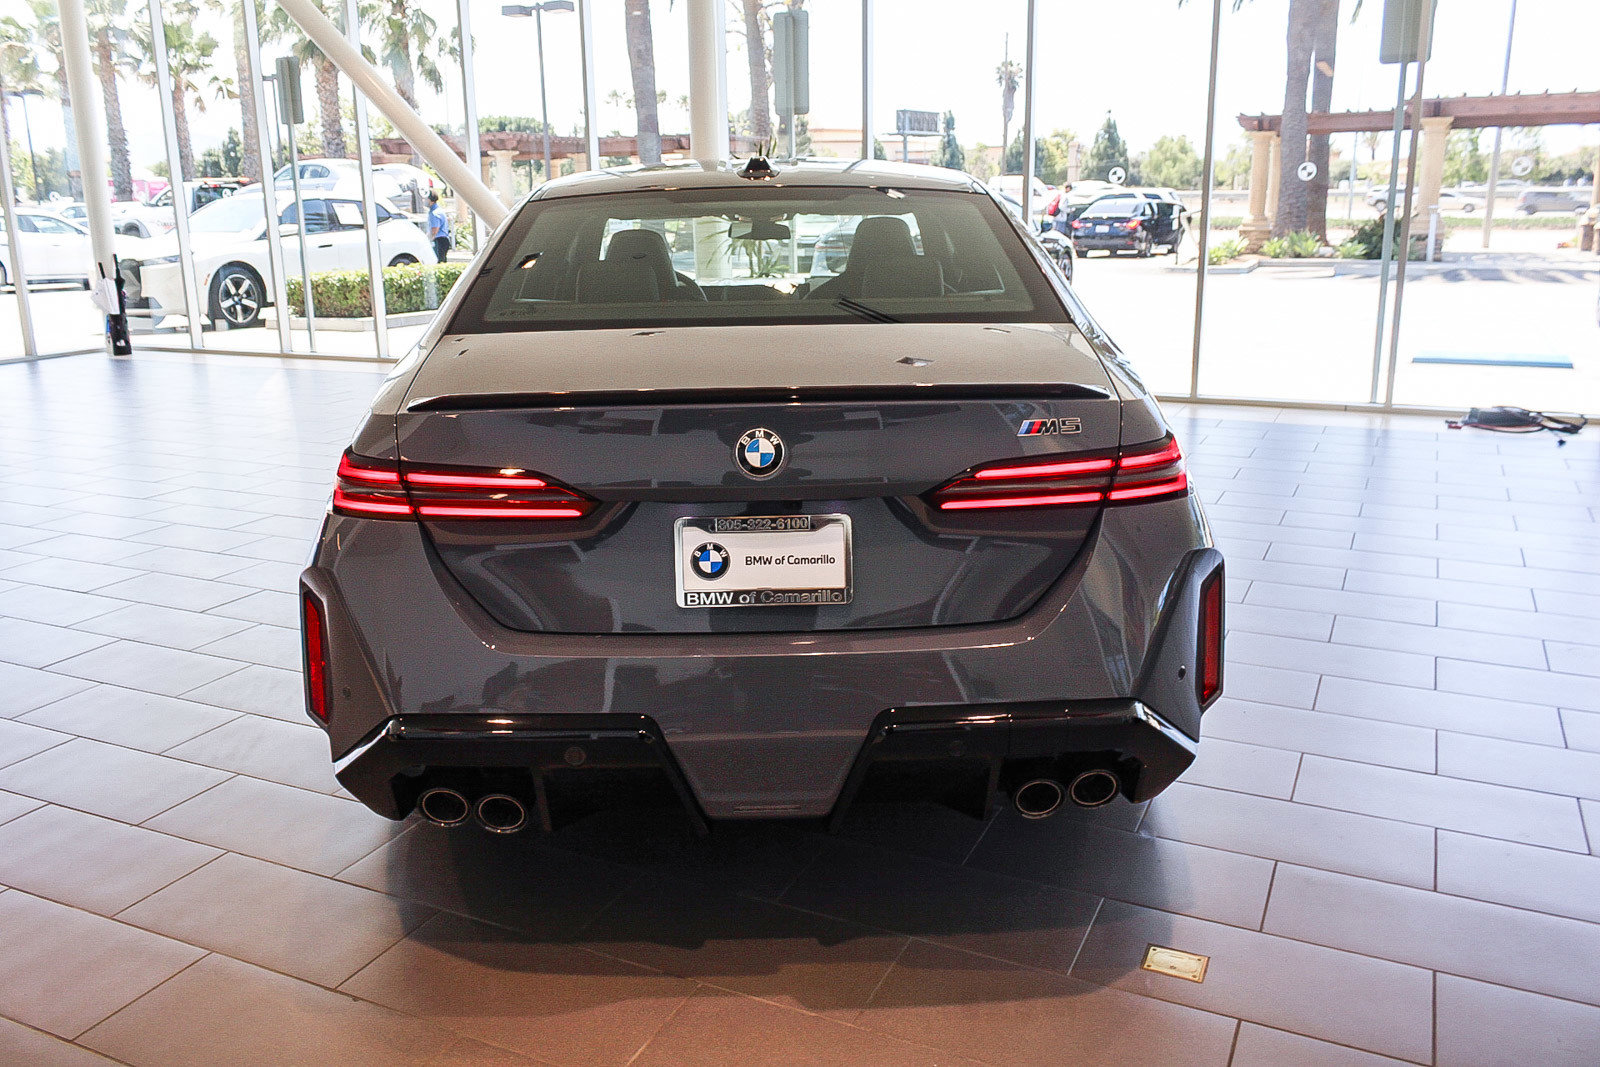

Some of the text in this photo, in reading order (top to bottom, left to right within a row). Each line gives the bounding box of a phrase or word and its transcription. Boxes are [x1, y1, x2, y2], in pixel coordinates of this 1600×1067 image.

[740, 430, 780, 446] BMW
[717, 518, 808, 531] 805-322-6100
[694, 543, 728, 558] BMW
[745, 554, 836, 566] BMW of Camarillo
[687, 589, 843, 606] BMW of Camarillo
